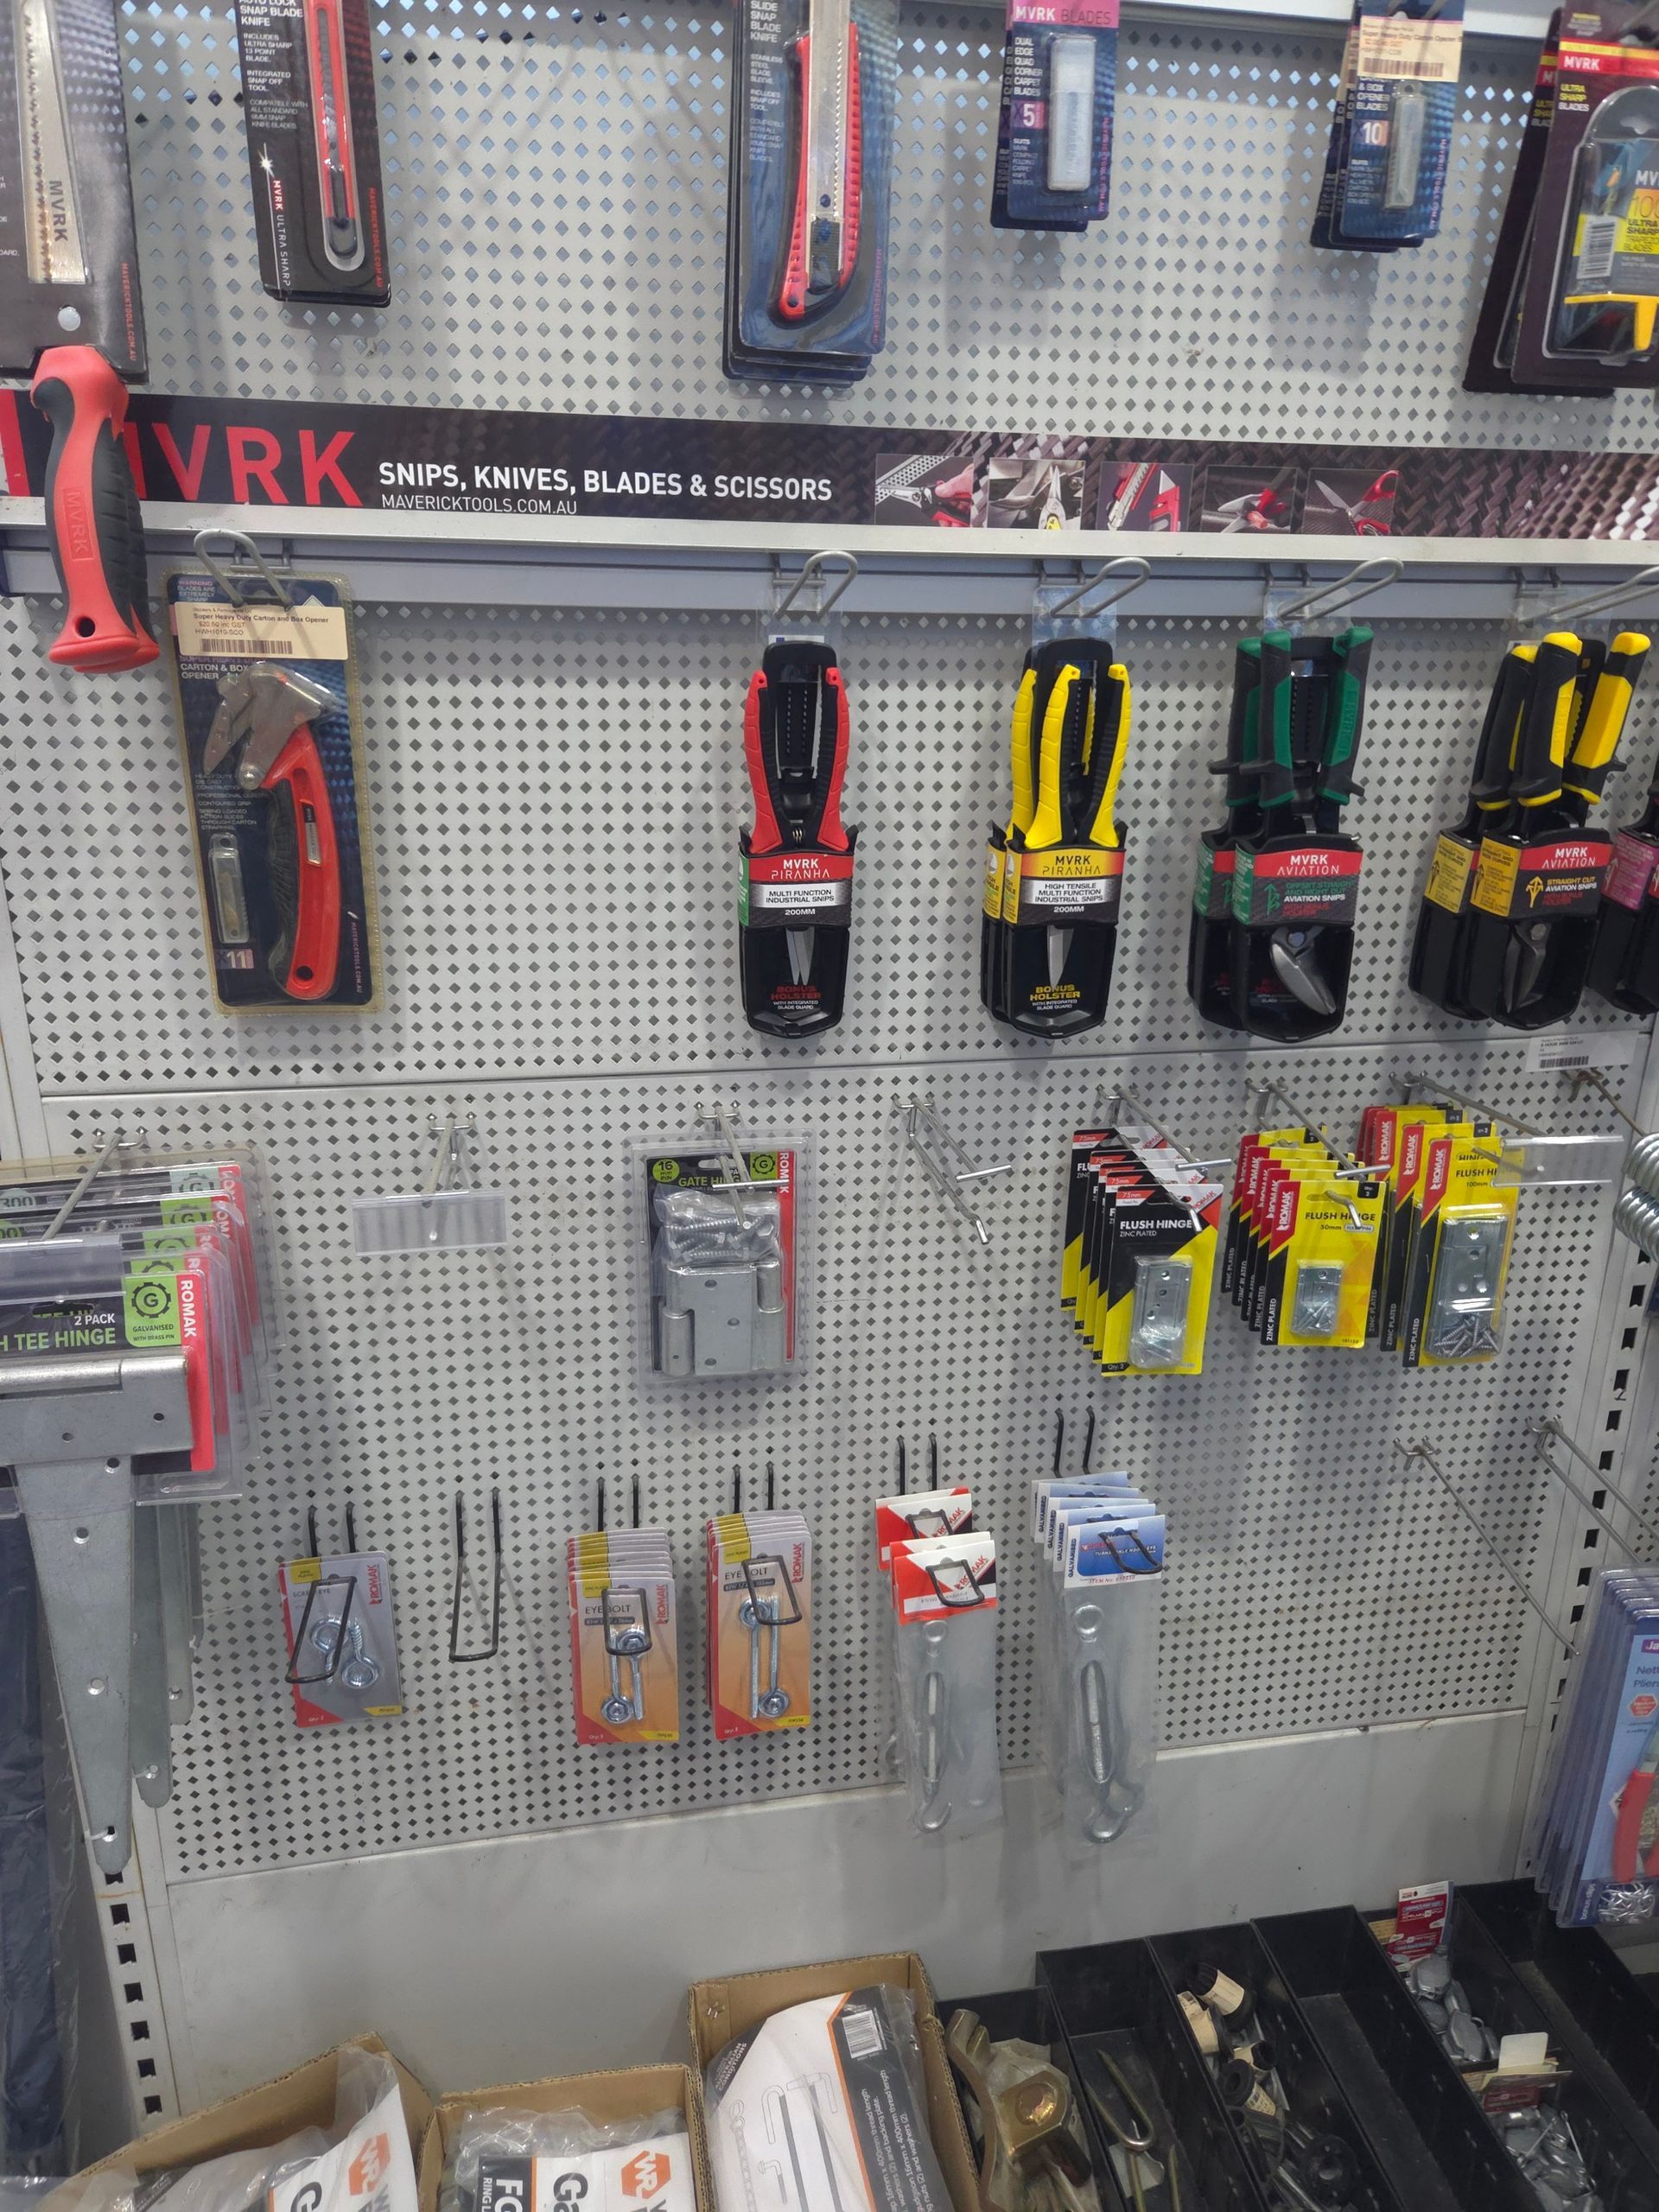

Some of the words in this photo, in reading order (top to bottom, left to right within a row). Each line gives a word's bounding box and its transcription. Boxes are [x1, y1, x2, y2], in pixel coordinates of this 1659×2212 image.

[240, 6, 267, 16] SNAP
[270, 8, 303, 17] BLADE
[750, 3, 778, 11] SLIDE
[750, 11, 777, 21] SNAP
[1016, 6, 1055, 22] MVRK
[1061, 9, 1111, 25] BLADES
[241, 16, 270, 27] KNIFE
[750, 21, 781, 33] BLADE
[750, 31, 779, 42] KNIFE
[1014, 37, 1033, 46] DUAL
[1014, 47, 1034, 56] EDGE
[1014, 56, 1034, 66] QUAD
[1564, 55, 1600, 71] MVRK
[247, 70, 291, 79] INTEGRATED
[1014, 67, 1043, 77] CORNER
[1014, 76, 1041, 87] CARPET
[1014, 86, 1041, 96] BLADES
[1560, 84, 1586, 93] ULTRA
[1357, 92, 1390, 102] OPENER
[1560, 92, 1586, 102] SHARP
[1356, 102, 1389, 111] BLADES
[1558, 102, 1590, 112] BLADES
[1635, 169, 1659, 186] MV
[273, 180, 284, 210] MVRK
[48, 180, 68, 242] MVRK
[1628, 219, 1658, 228] ULTRA
[276, 214, 287, 248] ULTRA
[280, 251, 291, 287] SHARP
[122, 421, 364, 506] VRK
[379, 462, 467, 492] SNIPS,
[474, 465, 576, 496] KNIVES,
[583, 469, 683, 497] BLADES
[690, 474, 708, 497] &
[714, 474, 833, 501] SCISSORS
[382, 493, 577, 516] MAVERICKTOOLS.COM.AU
[67, 492, 88, 555] MVRK
[193, 613, 213, 621] Super
[181, 671, 219, 680] OPENER
[1555, 847, 1588, 858] MVRK
[784, 858, 819, 869] MVRK
[1055, 855, 1091, 866] MVRK
[1290, 855, 1329, 865] MVRK
[1541, 857, 1596, 869] AVIATION
[772, 868, 830, 880] PIRANHA
[1042, 865, 1102, 875] PIRANHA
[1277, 865, 1339, 876] AVIATION
[1547, 876, 1581, 886] STRAIGHT
[1545, 884, 1577, 893] AVIATION
[1577, 882, 1598, 891] SNIPS
[1036, 984, 1076, 994] BONUS
[1029, 992, 1081, 1001] HOLSTER
[1405, 1134, 1418, 1171] ROMAK
[658, 1160, 674, 1171] 16
[760, 1160, 768, 1170] G
[1432, 1148, 1446, 1185] ROMAK
[1456, 1168, 1484, 1178] FLUSH
[678, 1177, 709, 1187] GATE
[1279, 1191, 1293, 1224] ROMAK
[1306, 1211, 1338, 1220] FLUSH
[1340, 1212, 1376, 1222] HIGE
[1120, 1220, 1154, 1230] FLUSH
[1155, 1219, 1192, 1229] HINGE
[143, 1292, 159, 1306] G
[180, 1279, 198, 1338] ROMAK
[1268, 1297, 1278, 1320] PLATED
[74, 1315, 82, 1325] 2
[85, 1313, 116, 1325] PACK
[132, 1324, 175, 1332] GALVANISED
[1265, 1319, 1274, 1342] ZINC
[1411, 1317, 1421, 1340] PLATED
[14, 1332, 50, 1351] TEE
[55, 1327, 117, 1349] HINGE
[1408, 1339, 1418, 1362] ZINC
[792, 1542, 803, 1578] ROMAK
[1068, 1538, 1077, 1578] GALVANISED
[725, 1570, 742, 1580] EYE
[367, 1564, 380, 1599] ROMAK
[656, 1584, 666, 1618] ROMAK
[1644, 1641, 1659, 1651] Ja
[1636, 1666, 1659, 1675] Nett
[718, 2043, 747, 2091] CONDITIONS
[885, 2090, 897, 2113] thread
[866, 2111, 879, 2135] thread
[890, 2113, 905, 2144] 400mm
[876, 2114, 891, 2145] backing
[903, 2123, 918, 2156] washers
[899, 2150, 913, 2177] 16mm
[912, 2156, 922, 2173] and
[482, 2177, 493, 2204] RING
